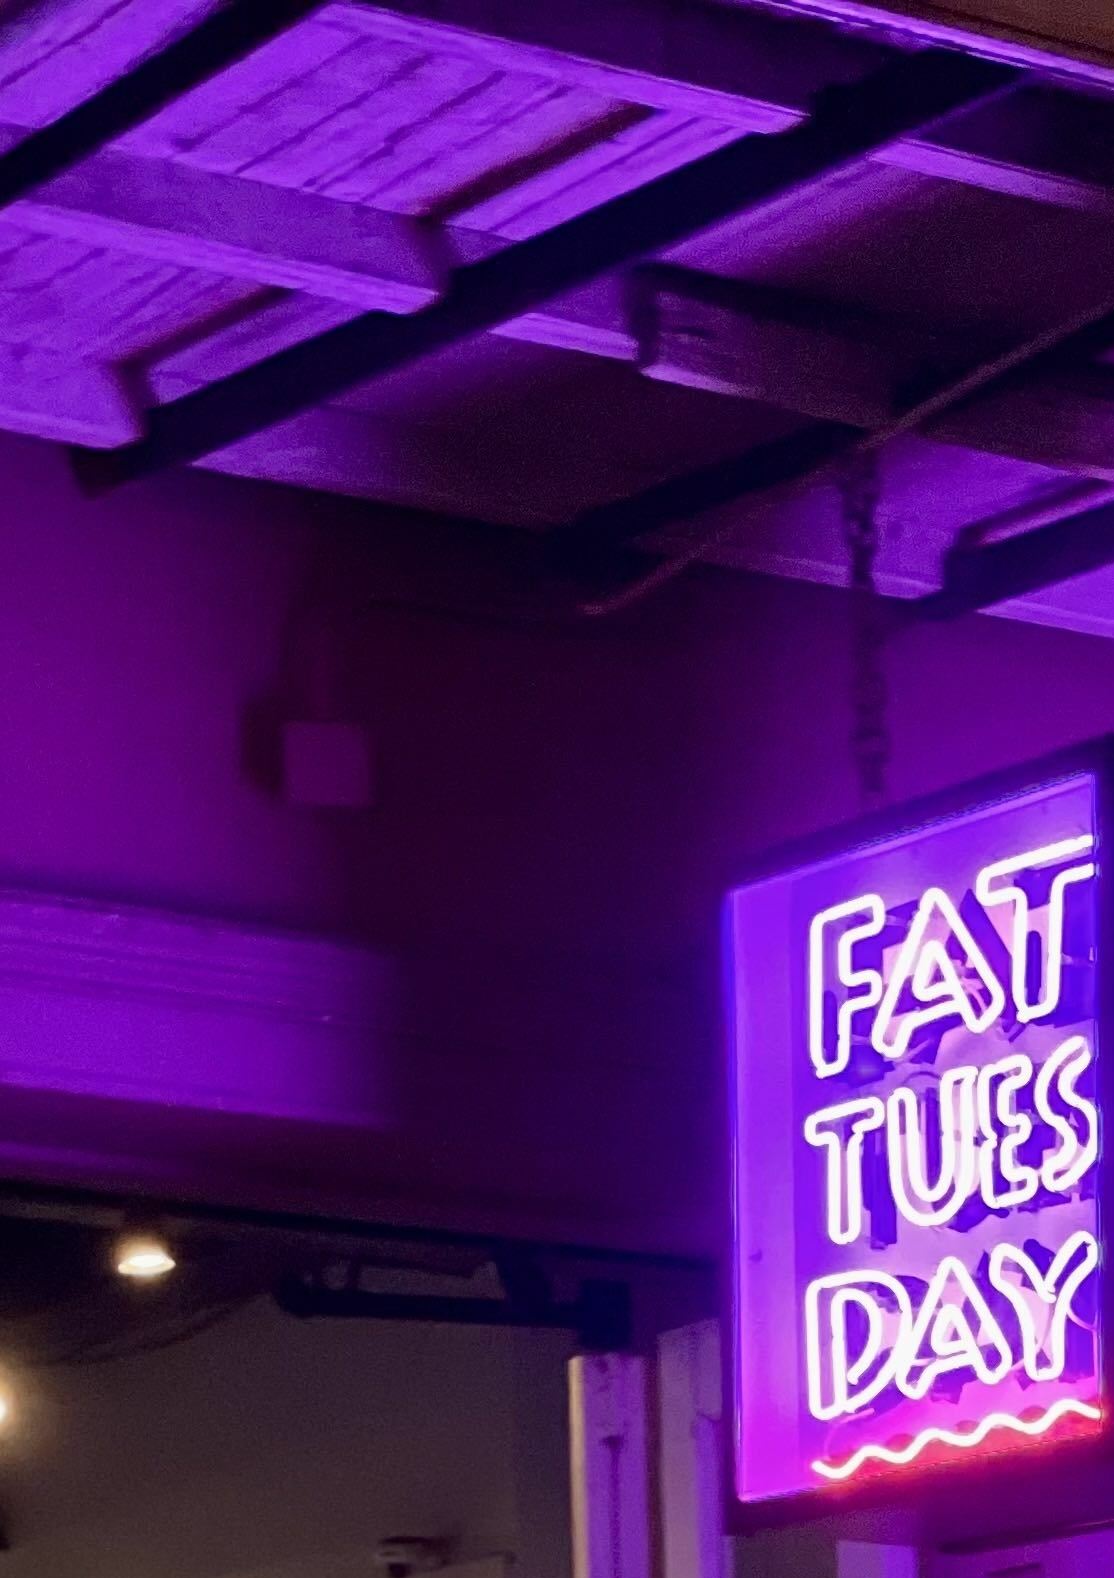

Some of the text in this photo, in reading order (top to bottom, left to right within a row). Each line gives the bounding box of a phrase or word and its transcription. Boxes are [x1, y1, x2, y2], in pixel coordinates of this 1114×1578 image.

[809, 833, 1095, 1079] FAT
[804, 1036, 1098, 1245] TUES
[805, 1230, 1098, 1420] DAY
